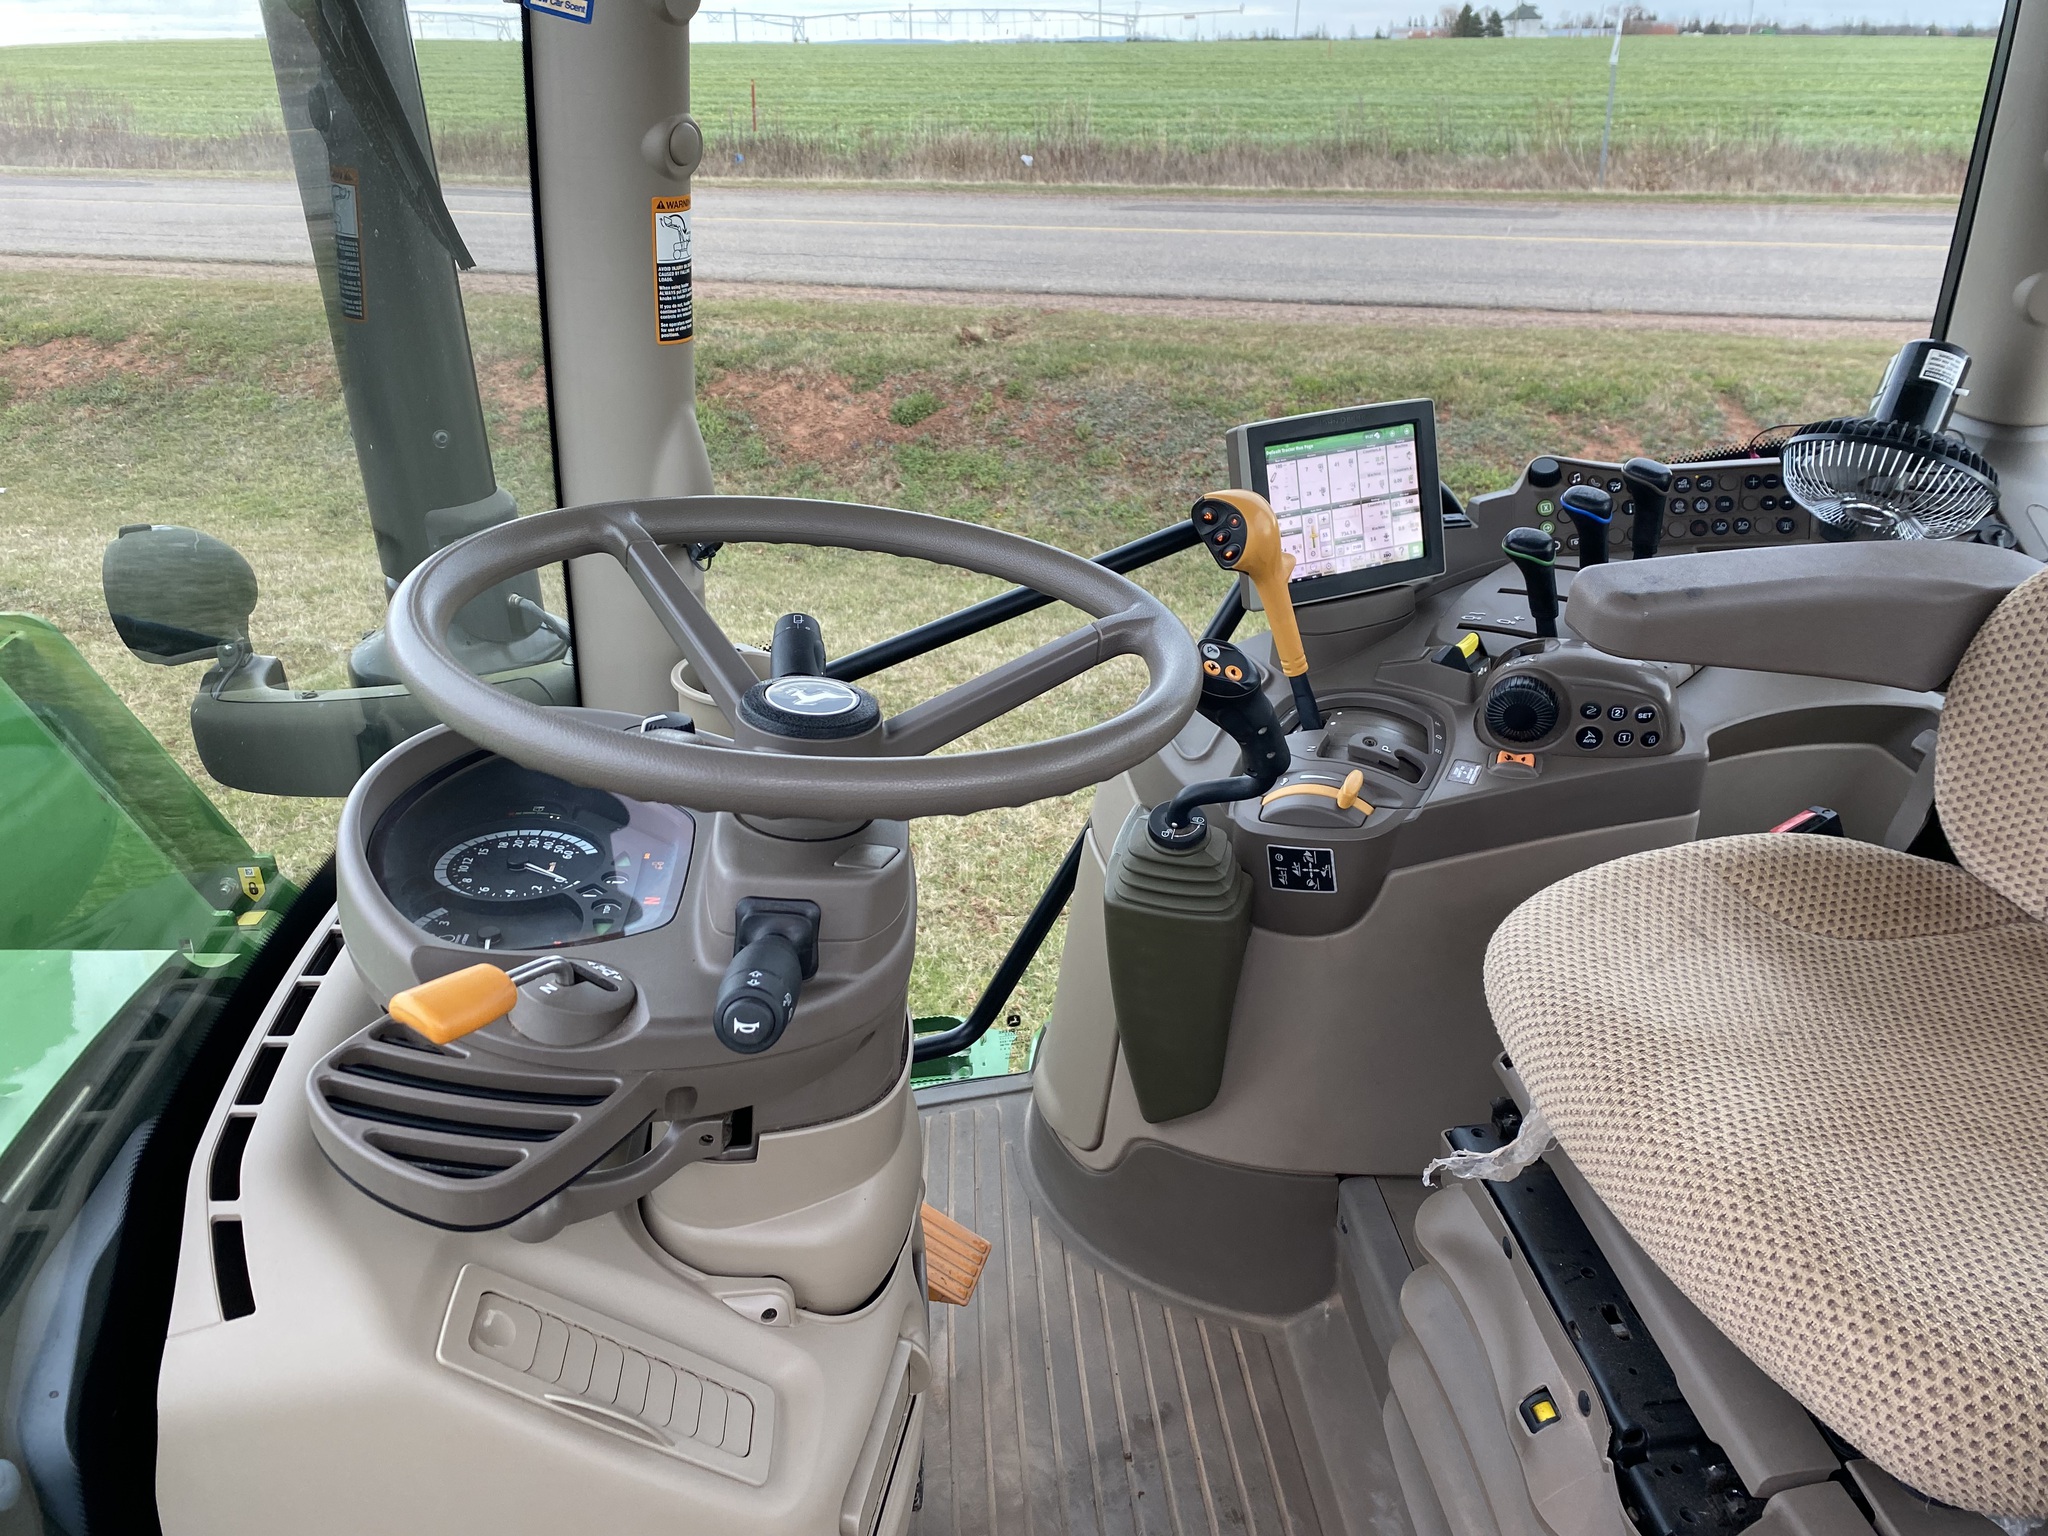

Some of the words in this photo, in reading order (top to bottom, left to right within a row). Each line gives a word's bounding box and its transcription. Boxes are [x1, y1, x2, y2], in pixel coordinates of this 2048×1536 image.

[565, 1, 586, 13] Scent
[666, 198, 690, 209] WARN
[1382, 745, 1392, 753] P
[513, 839, 524, 848] 20
[528, 839, 540, 848] 30
[543, 841, 554, 850] 40
[554, 845, 565, 854] 50
[562, 850, 574, 860] 60
[539, 983, 558, 994] N
